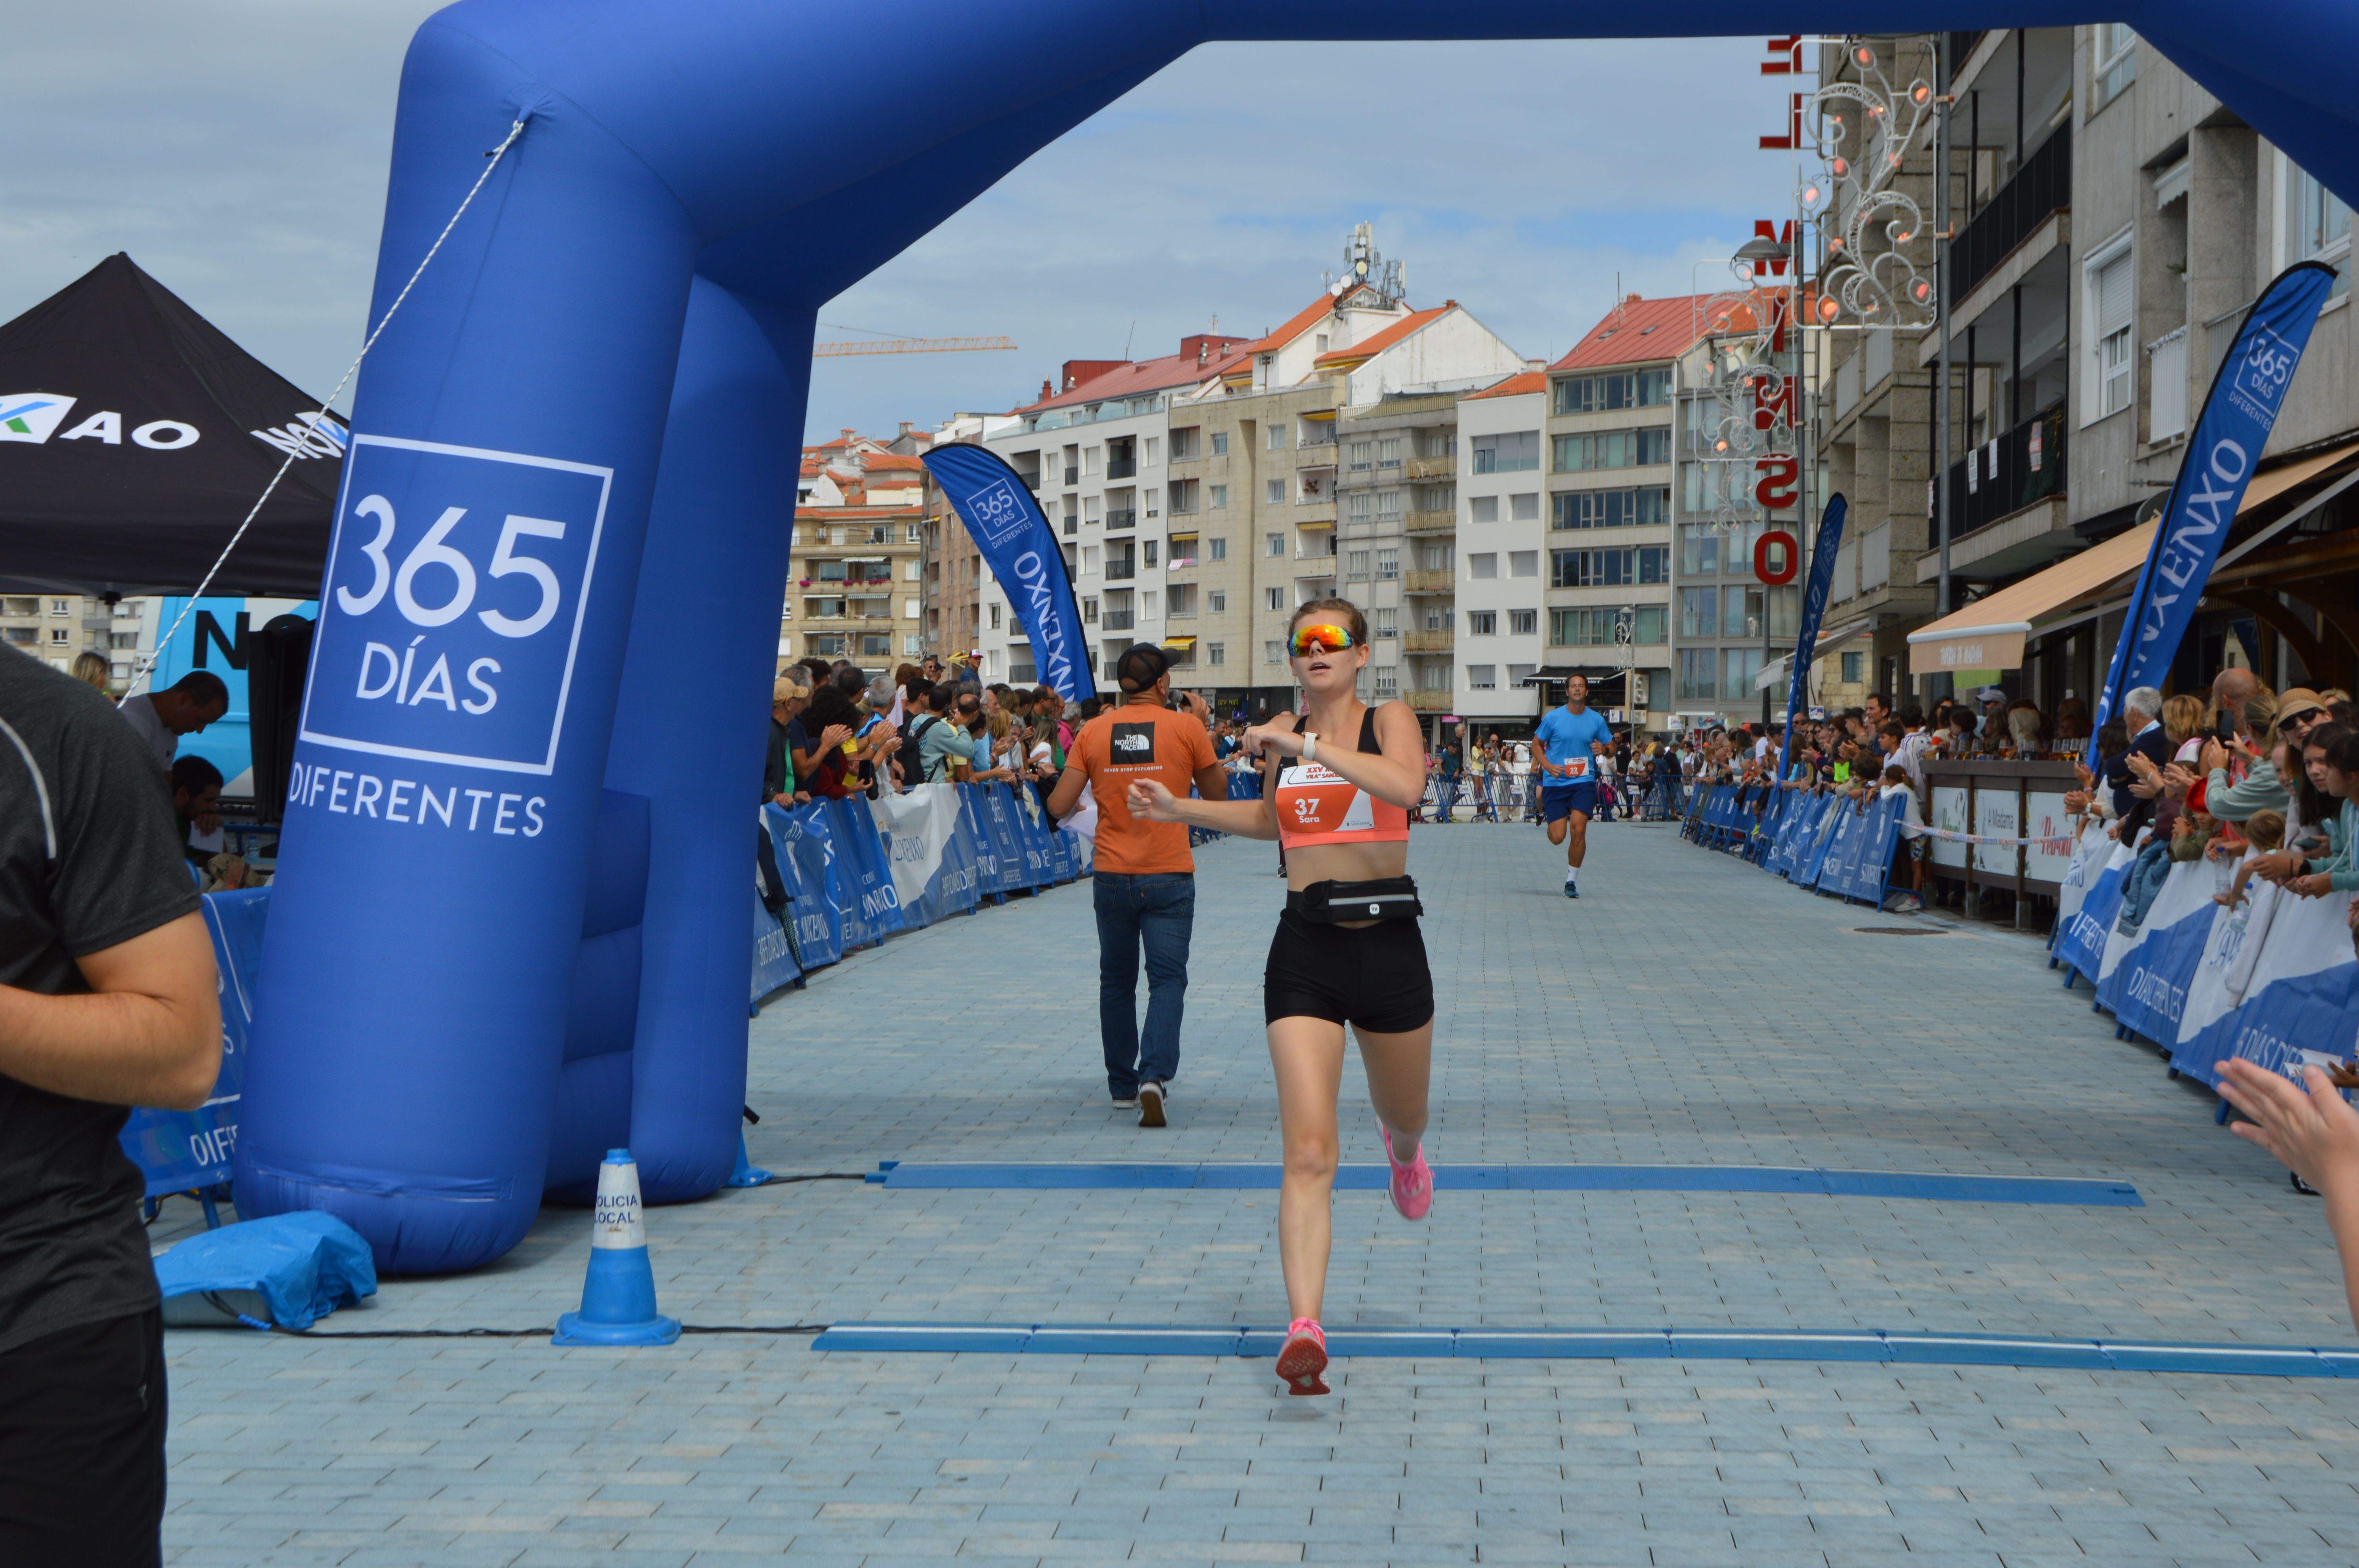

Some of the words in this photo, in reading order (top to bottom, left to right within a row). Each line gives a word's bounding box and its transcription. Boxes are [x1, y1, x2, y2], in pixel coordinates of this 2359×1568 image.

[2249, 339, 2290, 385] 365
[2252, 373, 2274, 399] DÍAS
[2229, 391, 2272, 431] DIFERENTES
[976, 489, 1012, 520] 365
[993, 510, 1015, 528] DÍAS
[992, 521, 1033, 549] DIFERENTES
[336, 495, 566, 637] 365
[356, 635, 501, 715] DÍAS
[289, 762, 546, 837] DIFERENTES
[1295, 798, 1320, 815] 37
[1992, 808, 2014, 829] Madama
[597, 1194, 638, 1207] OLICIA
[594, 1211, 635, 1224] LOCAL
